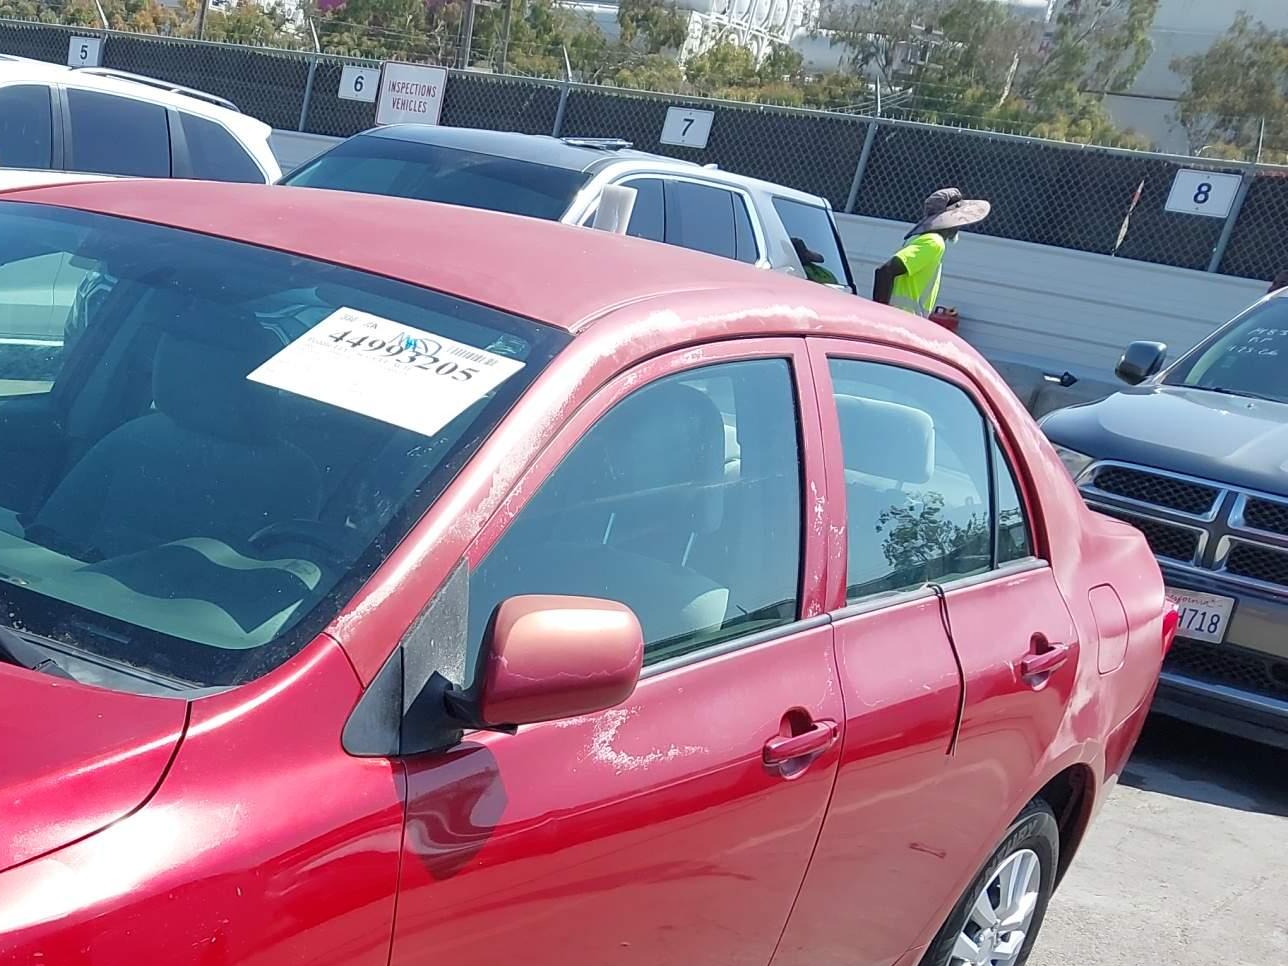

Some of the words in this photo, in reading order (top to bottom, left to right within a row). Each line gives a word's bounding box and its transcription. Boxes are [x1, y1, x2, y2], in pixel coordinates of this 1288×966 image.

[79, 45, 88, 60] 5
[354, 75, 365, 92] 6
[388, 80, 437, 98] INSPECTIONS
[392, 97, 428, 113] VEHICLES
[682, 118, 695, 137] 7
[1193, 182, 1212, 204] 8
[328, 329, 480, 382] 44993205
